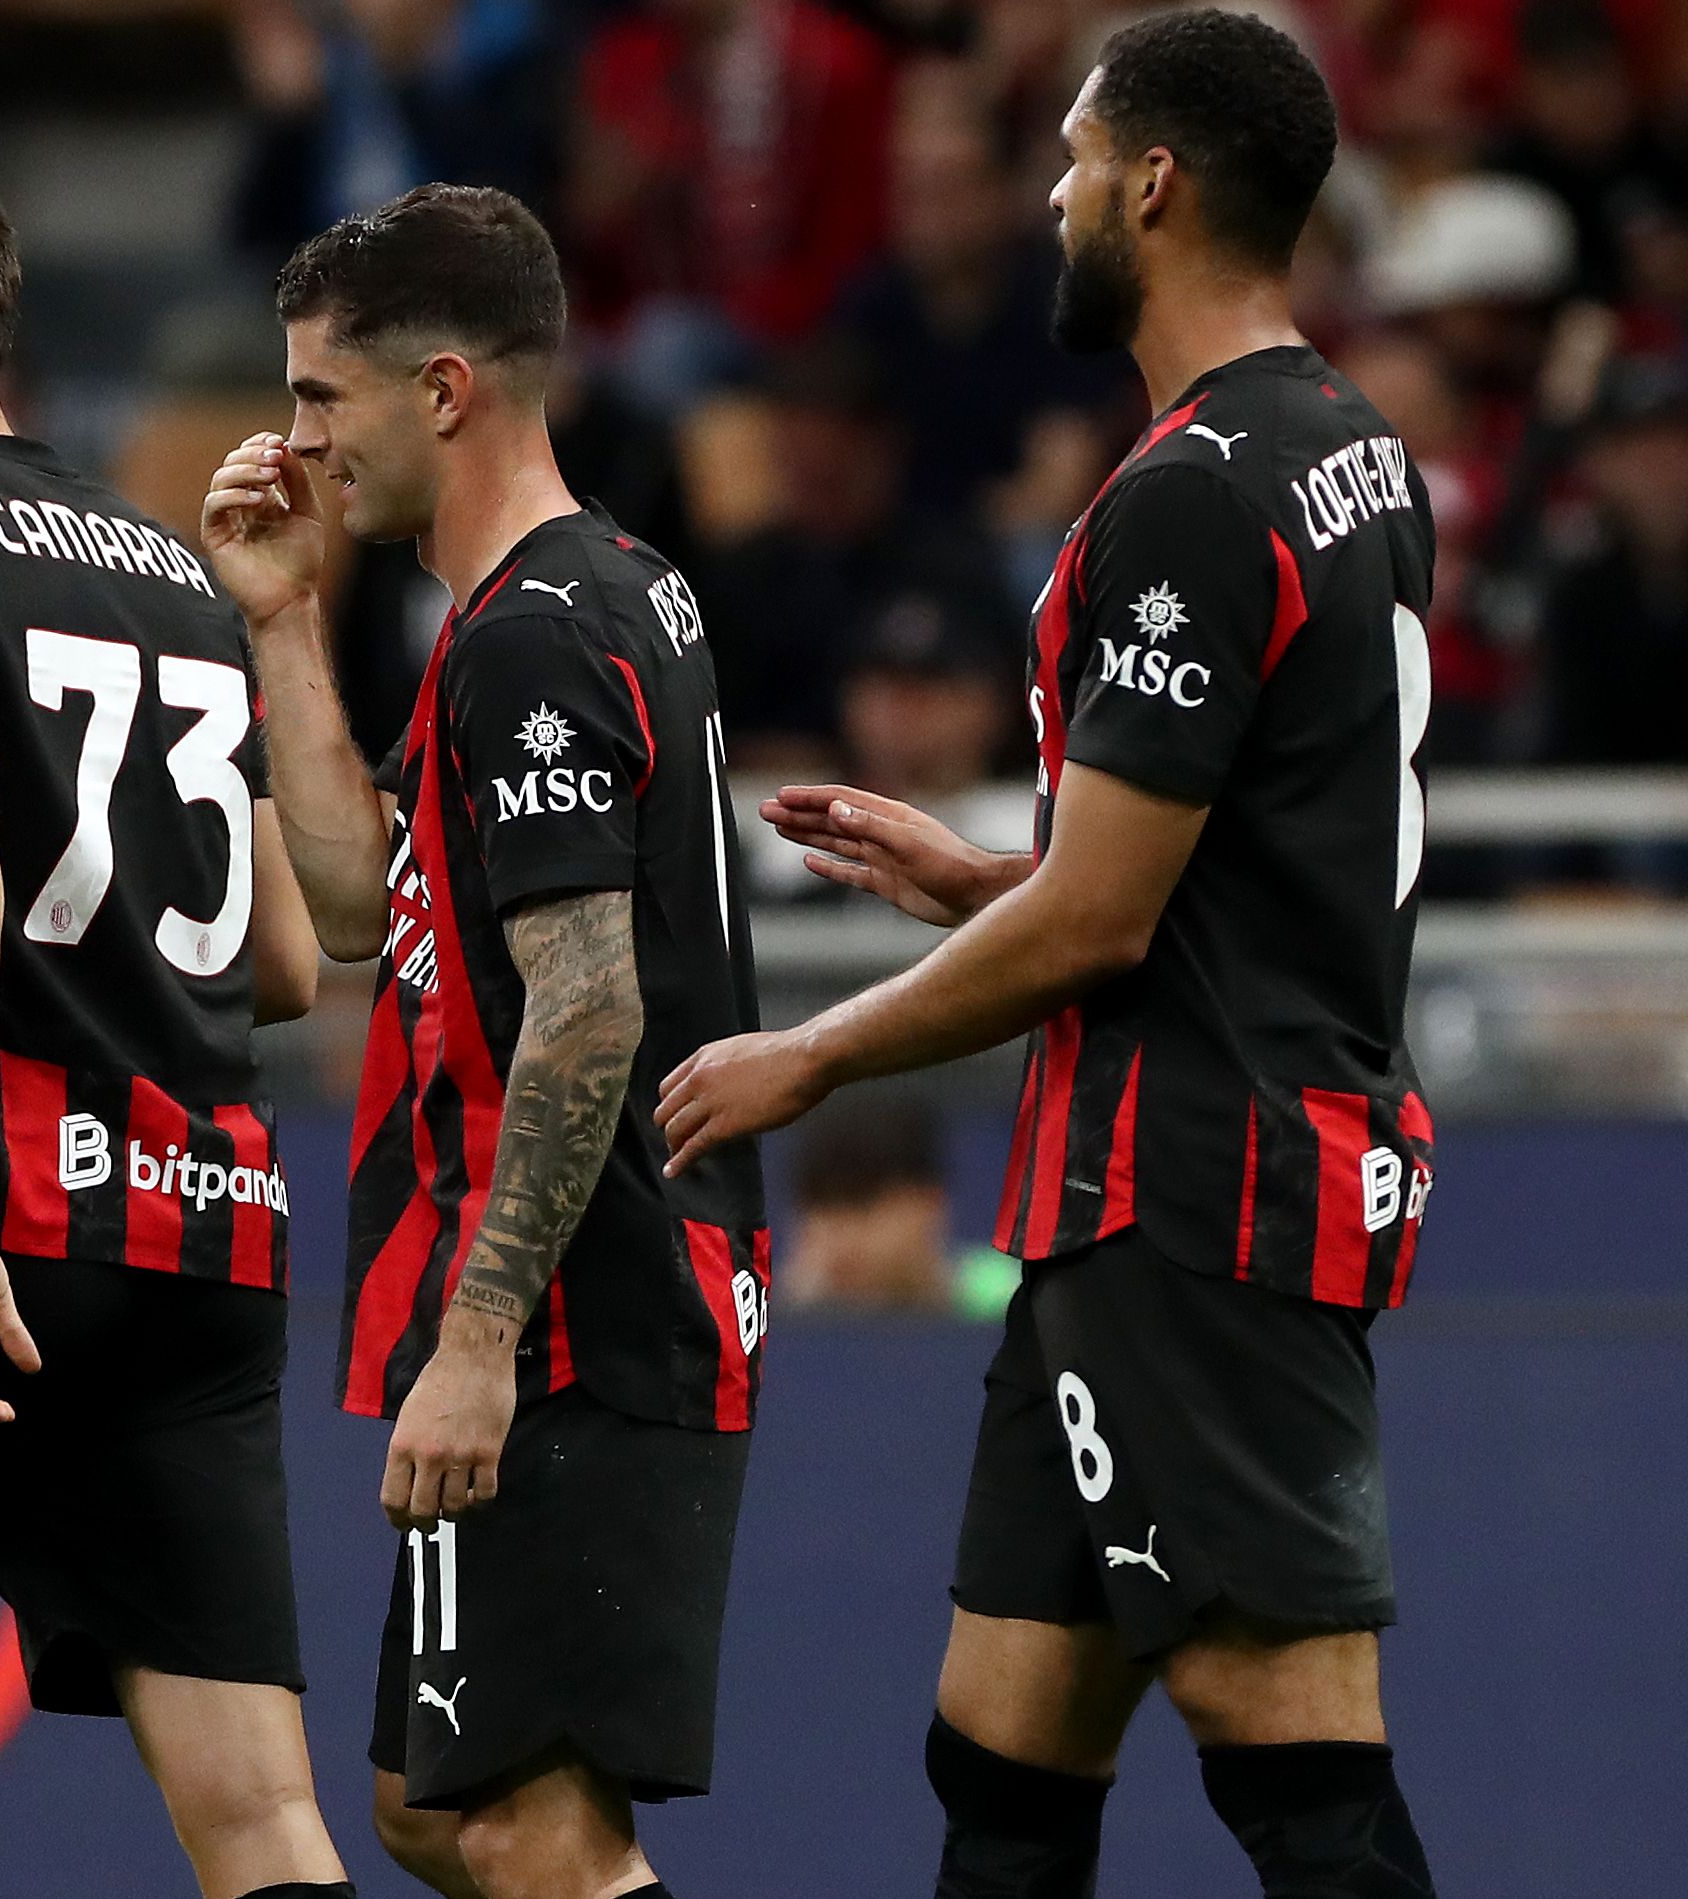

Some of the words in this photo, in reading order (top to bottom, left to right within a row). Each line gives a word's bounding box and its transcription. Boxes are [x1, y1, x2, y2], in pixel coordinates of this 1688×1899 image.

[1098, 637, 1212, 708] MSC
[23, 628, 253, 976] 73
[492, 768, 613, 822] MSC
[129, 1139, 290, 1217] bitpanda
[1057, 1371, 1113, 1502] 8
[408, 1518, 457, 1656] 11
